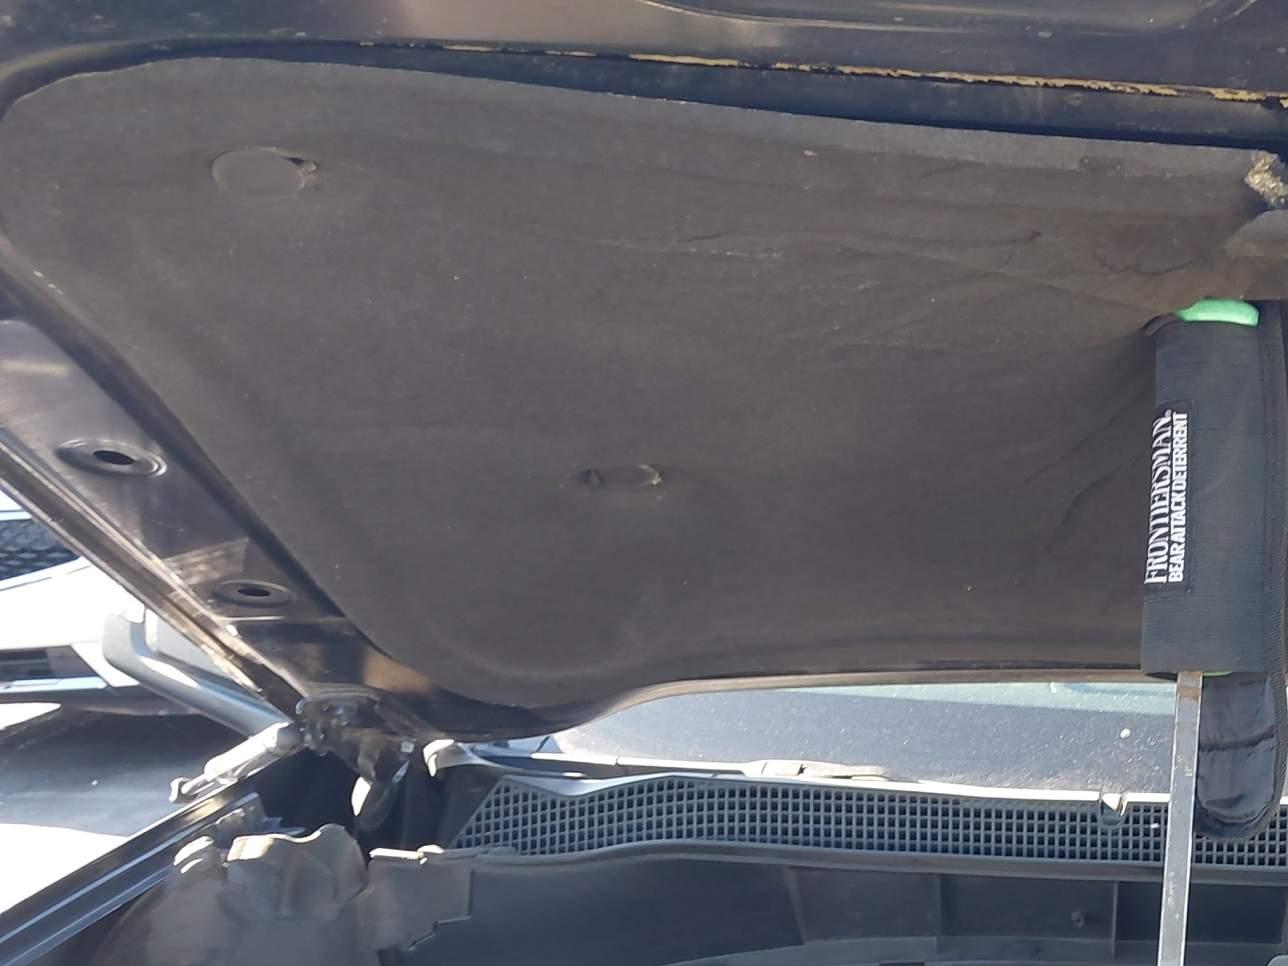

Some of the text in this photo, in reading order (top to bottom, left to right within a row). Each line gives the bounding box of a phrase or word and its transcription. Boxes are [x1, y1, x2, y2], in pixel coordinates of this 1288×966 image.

[1168, 411, 1188, 583] BEAR ATTACK DETERRENT
